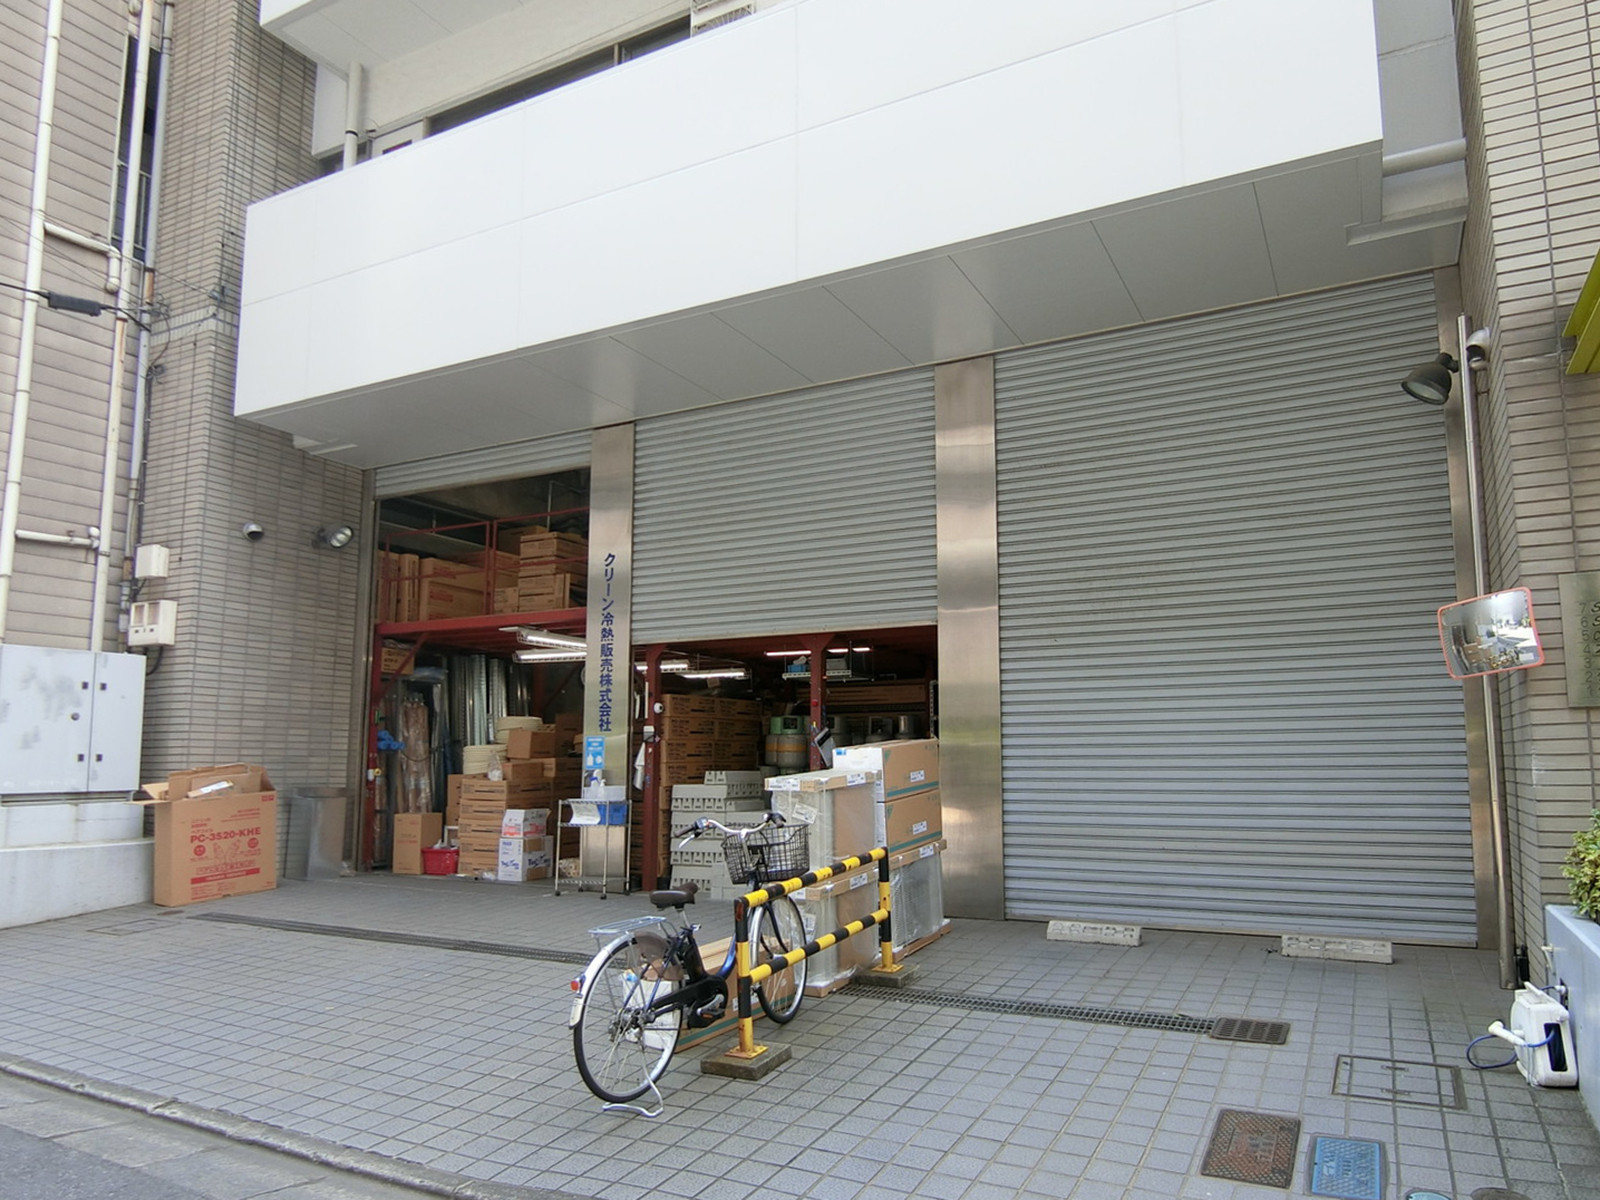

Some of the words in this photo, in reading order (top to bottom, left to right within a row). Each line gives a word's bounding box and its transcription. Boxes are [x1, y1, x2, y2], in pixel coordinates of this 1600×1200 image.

[599, 553, 616, 732] クリーン冷熱販売株式会社
[190, 827, 261, 844] PC-3520-KHE
